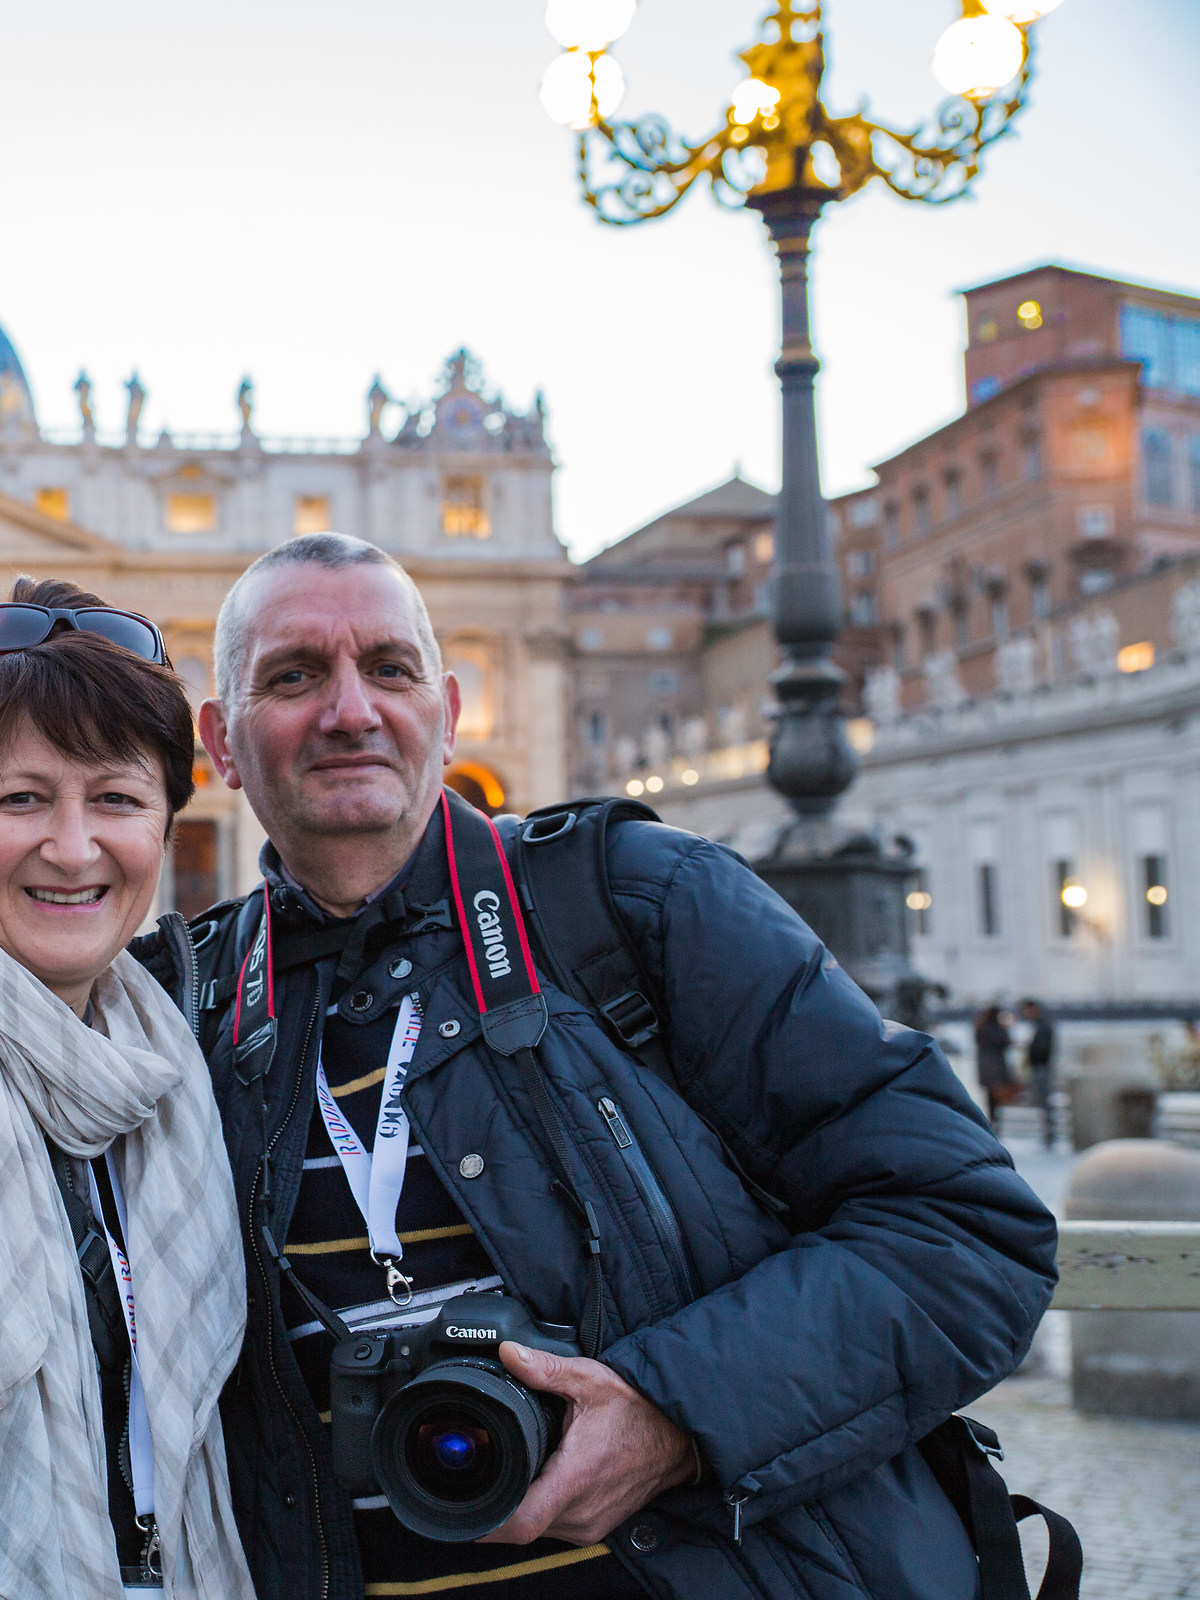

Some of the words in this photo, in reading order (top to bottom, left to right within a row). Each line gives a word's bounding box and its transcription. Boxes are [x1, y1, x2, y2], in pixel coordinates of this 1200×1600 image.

[473, 889, 512, 979] Canon
[246, 970, 264, 1007] 7D
[318, 1085, 361, 1155] RADUNO
[445, 1325, 498, 1340] Canon
